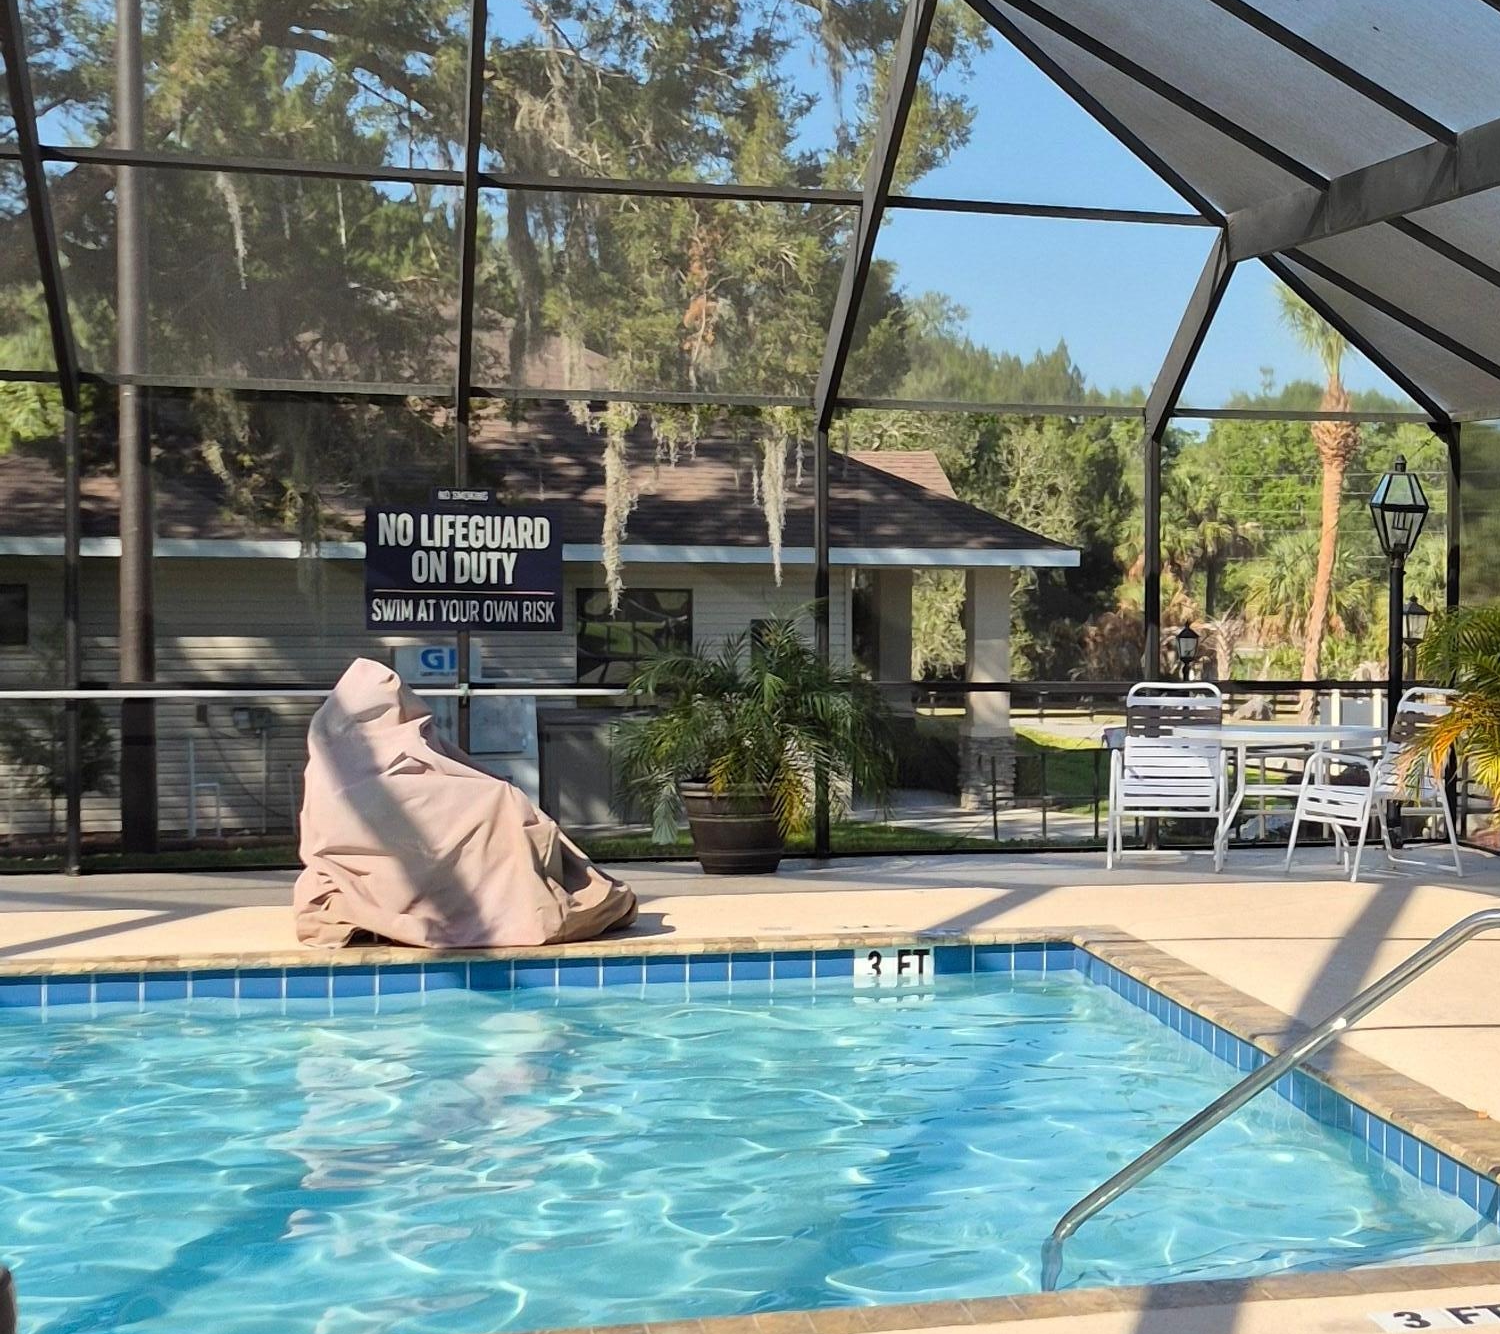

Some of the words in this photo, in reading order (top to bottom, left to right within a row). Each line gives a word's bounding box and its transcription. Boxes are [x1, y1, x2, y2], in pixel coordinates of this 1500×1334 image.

[378, 512, 414, 547] NO
[420, 514, 551, 549] LIFEGUARD
[411, 550, 447, 584] ON
[453, 551, 518, 585] DUTY
[371, 598, 414, 622] SWIM
[416, 599, 437, 622] AT
[439, 599, 480, 623] YOUR
[483, 600, 519, 623] OWN
[522, 601, 556, 623] RISK
[867, 950, 882, 975] 3
[897, 948, 931, 975] FT
[1393, 1311, 1432, 1329] 3
